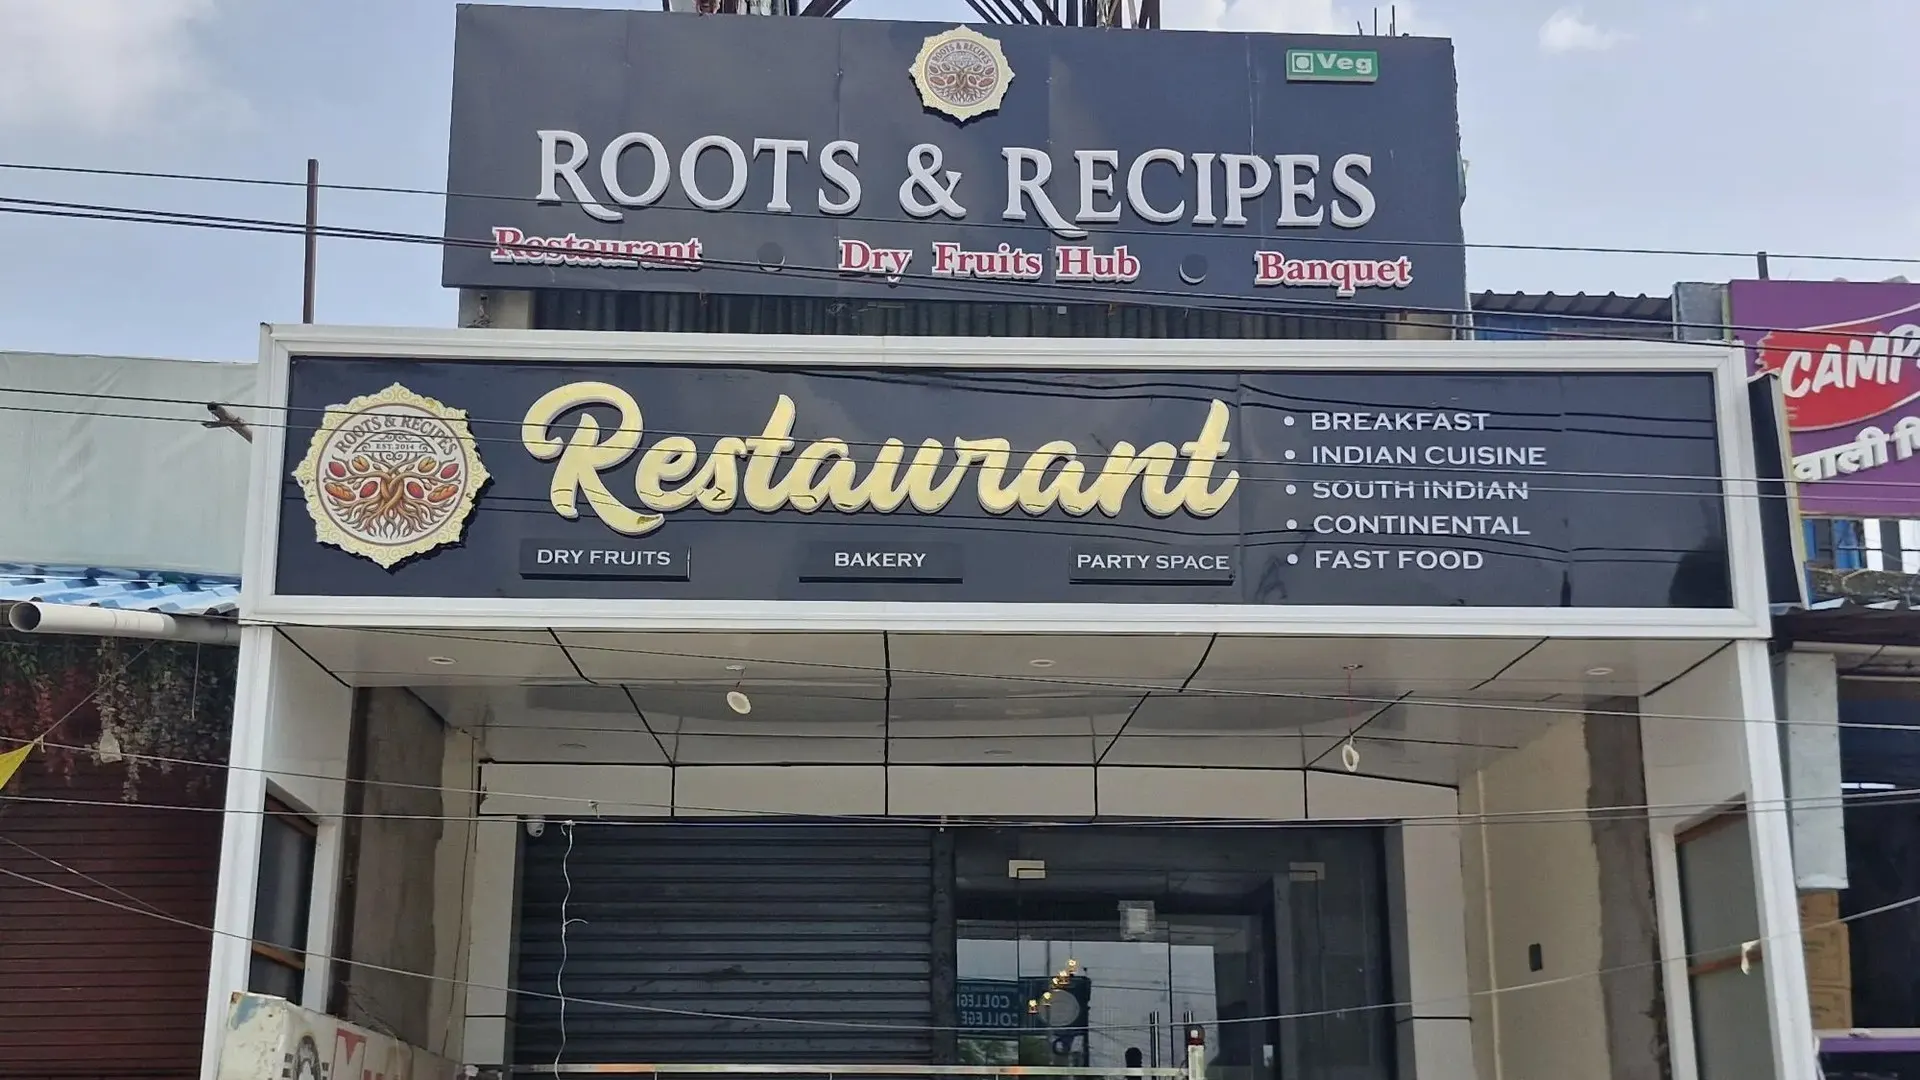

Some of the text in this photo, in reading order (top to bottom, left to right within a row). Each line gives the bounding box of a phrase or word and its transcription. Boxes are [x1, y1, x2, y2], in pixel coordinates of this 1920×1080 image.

[1316, 52, 1373, 75] Veg
[535, 129, 1376, 238] ROOTS & RECIPES
[490, 226, 703, 269] Restaurant
[838, 239, 1141, 283] Dry Fruits Hub
[1253, 249, 1413, 297] Banquet
[1781, 324, 1920, 398] CAMP
[1311, 412, 1490, 431] BREAKFAST
[335, 414, 458, 456] ROOTS & RECIPES
[521, 381, 1240, 534] Restaurant
[1312, 446, 1547, 465] INDIAN CUISINE
[1312, 480, 1529, 500] SOUTH INDIAN
[1313, 515, 1531, 535] CONTINENTAL
[537, 549, 671, 566] DRY FRUITS
[834, 552, 926, 568] BAKERY
[1077, 554, 1231, 571] PARTY SPACE
[1315, 550, 1483, 569] FAST FOOD
